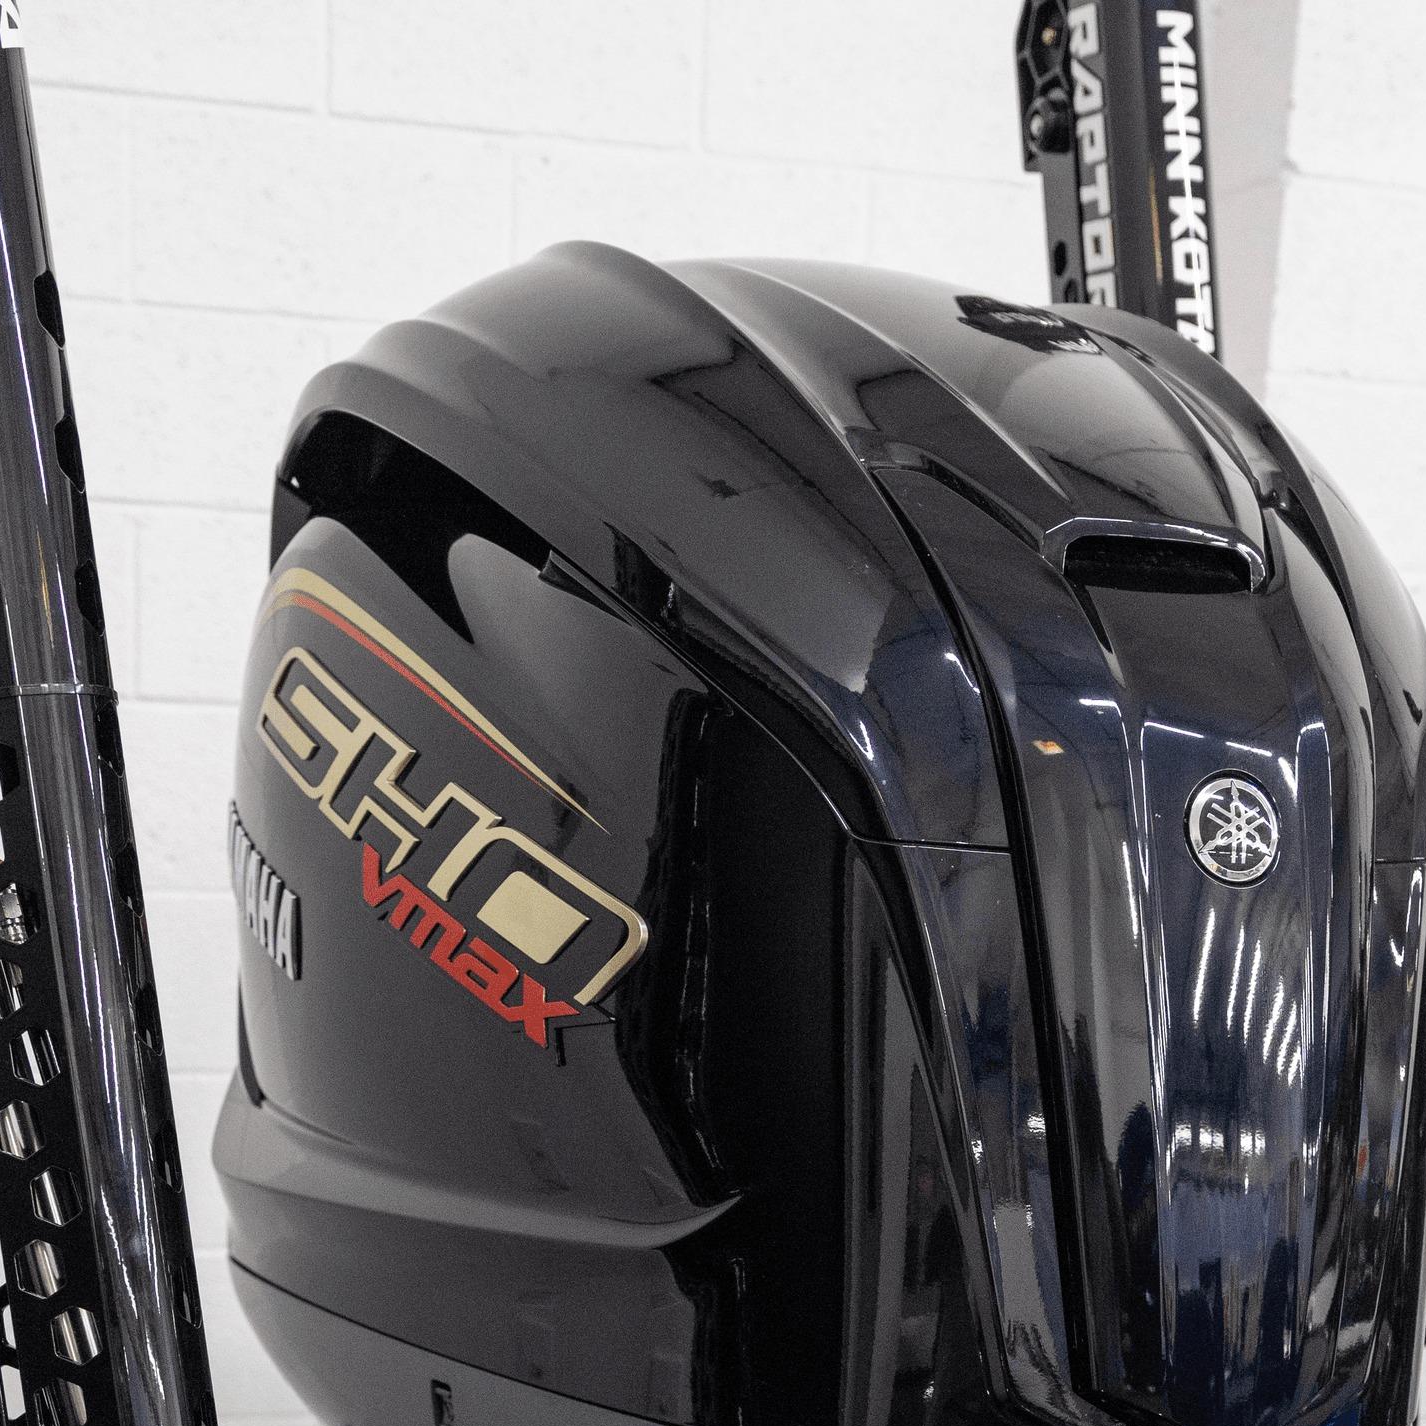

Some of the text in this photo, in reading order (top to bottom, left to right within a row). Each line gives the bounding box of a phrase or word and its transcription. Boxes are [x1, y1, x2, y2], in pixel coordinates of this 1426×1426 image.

[1156, 10, 1204, 182] MINN
[228, 799, 300, 981] MAHA
[257, 646, 649, 1006] SHO
